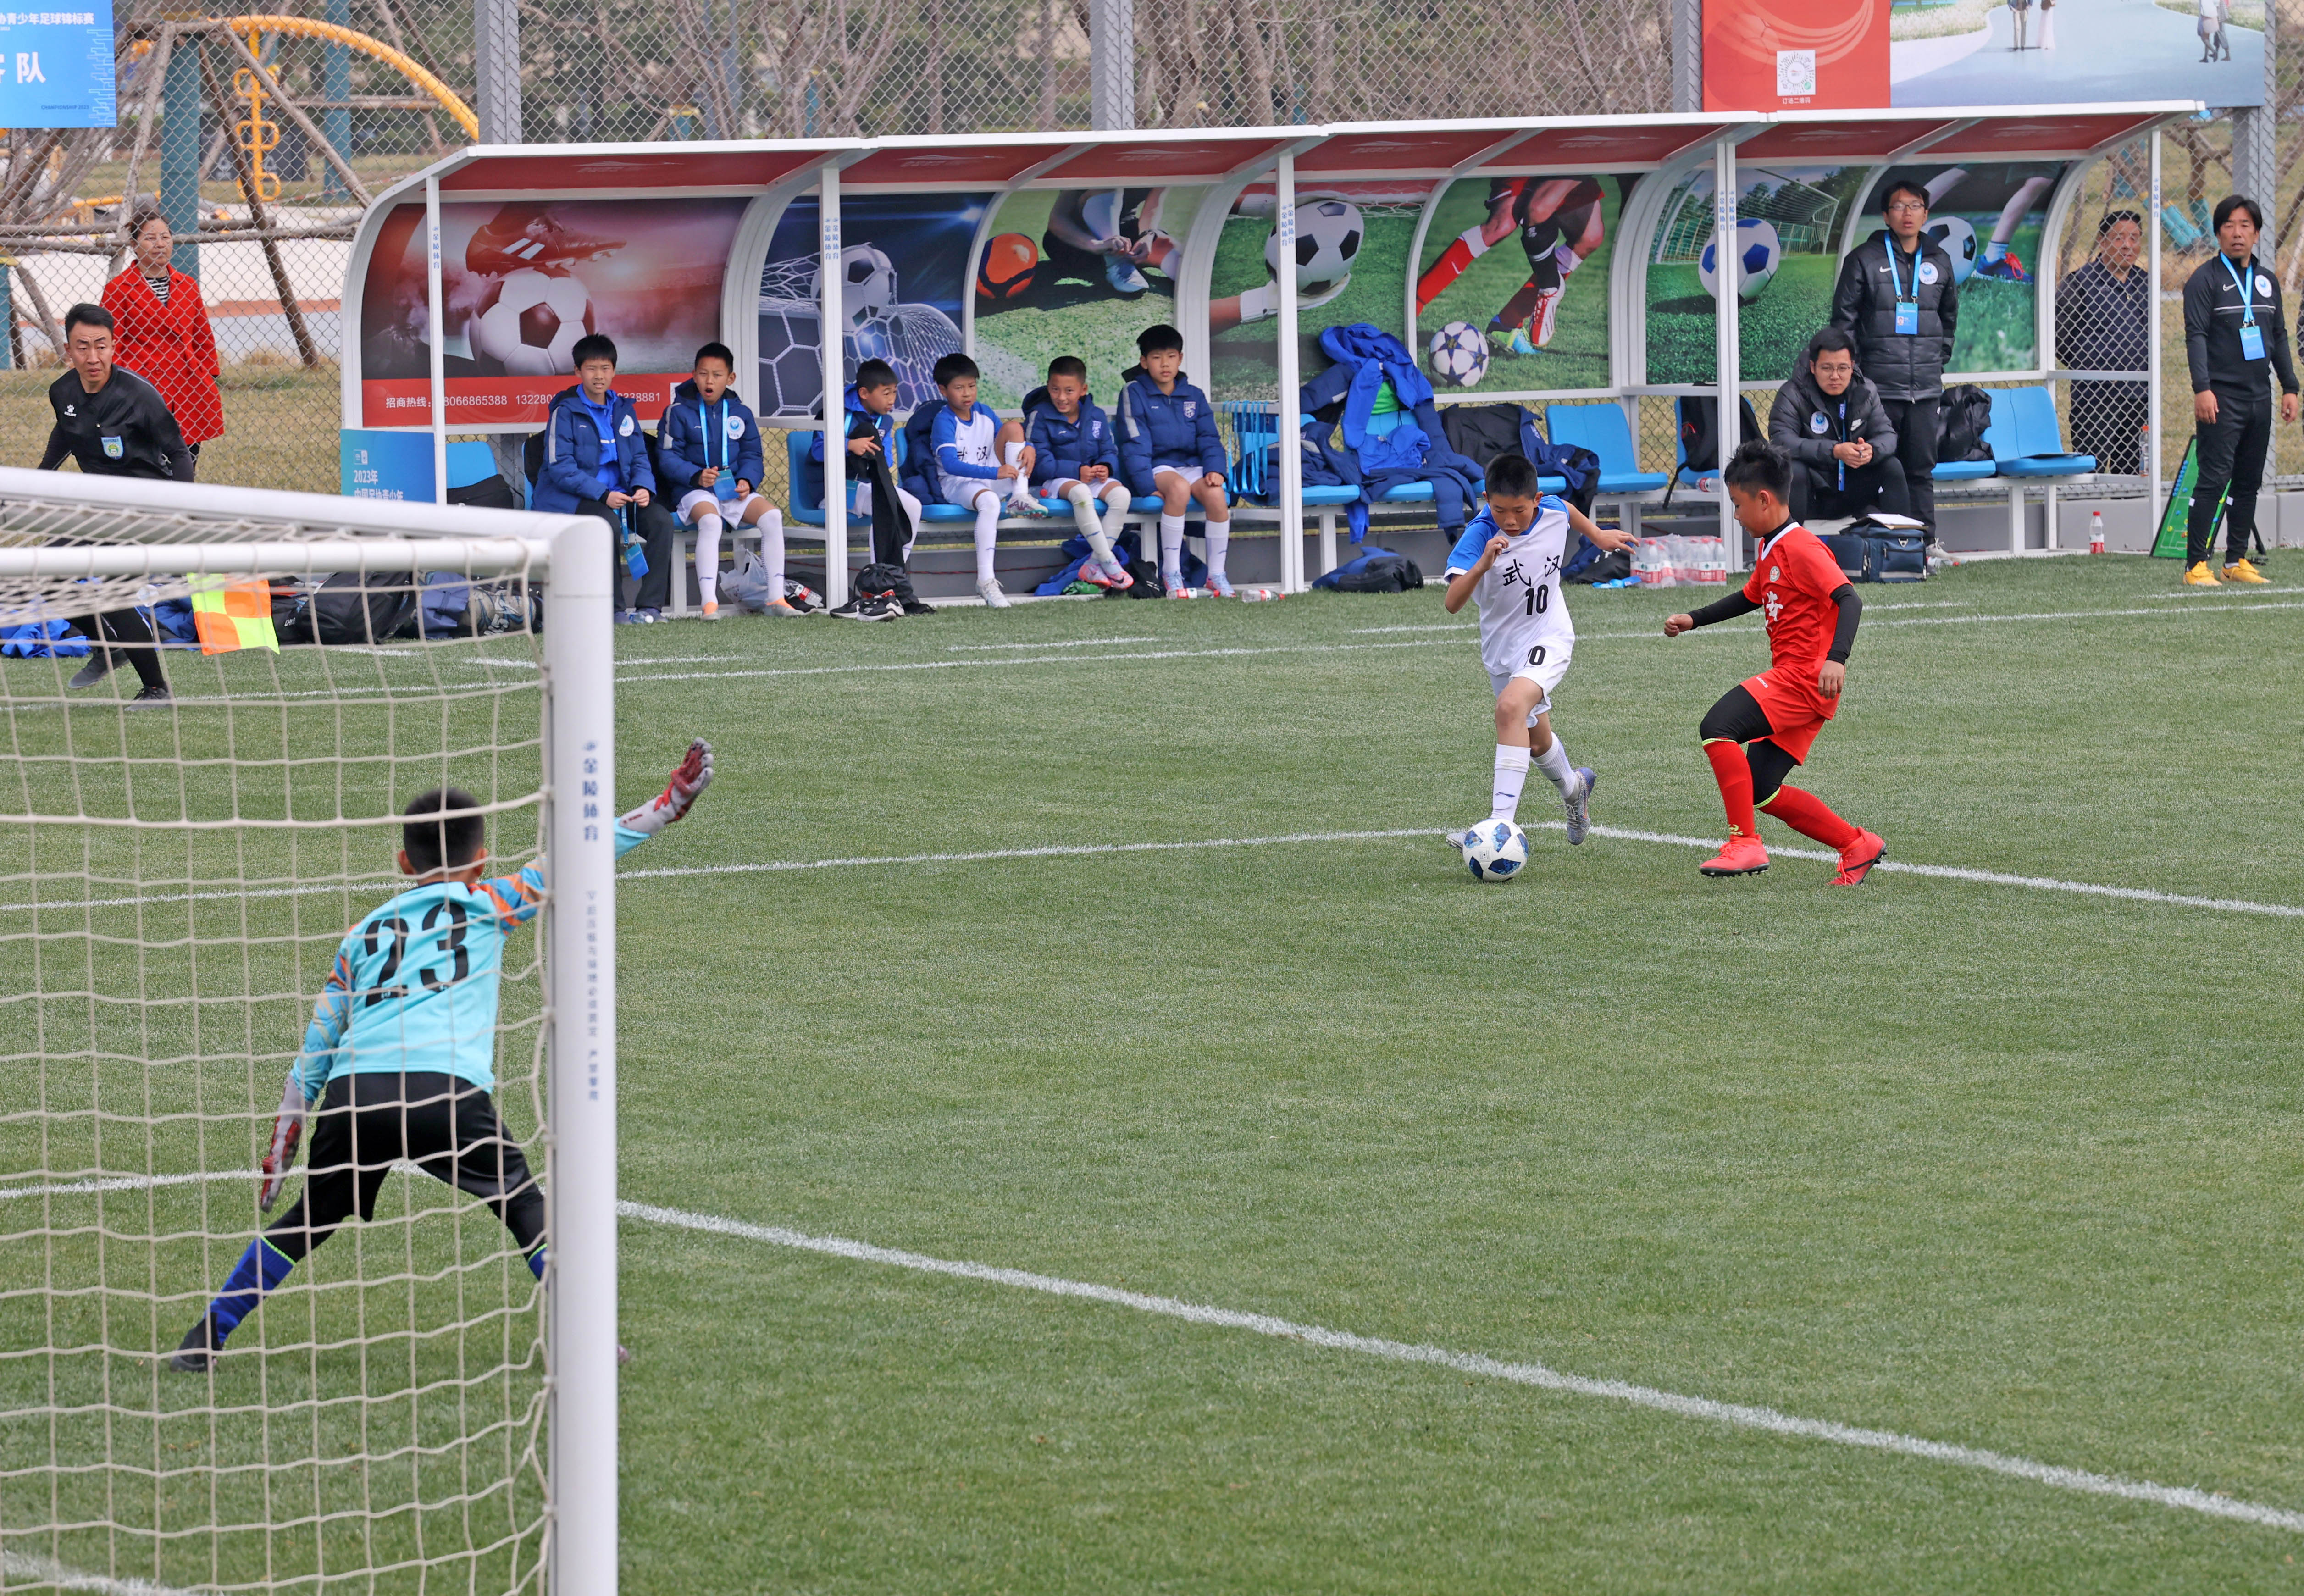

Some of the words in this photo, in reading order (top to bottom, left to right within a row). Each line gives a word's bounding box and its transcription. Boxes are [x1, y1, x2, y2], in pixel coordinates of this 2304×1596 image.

[444, 395, 508, 406] 8066865388
[515, 394, 556, 405] 132280
[354, 469, 378, 485] 2023年
[1502, 555, 1561, 587] 武汉
[1525, 584, 1548, 615] 10
[1527, 645, 1546, 666] 0
[582, 757, 598, 841] 金陵体育
[364, 902, 469, 1008] 23
